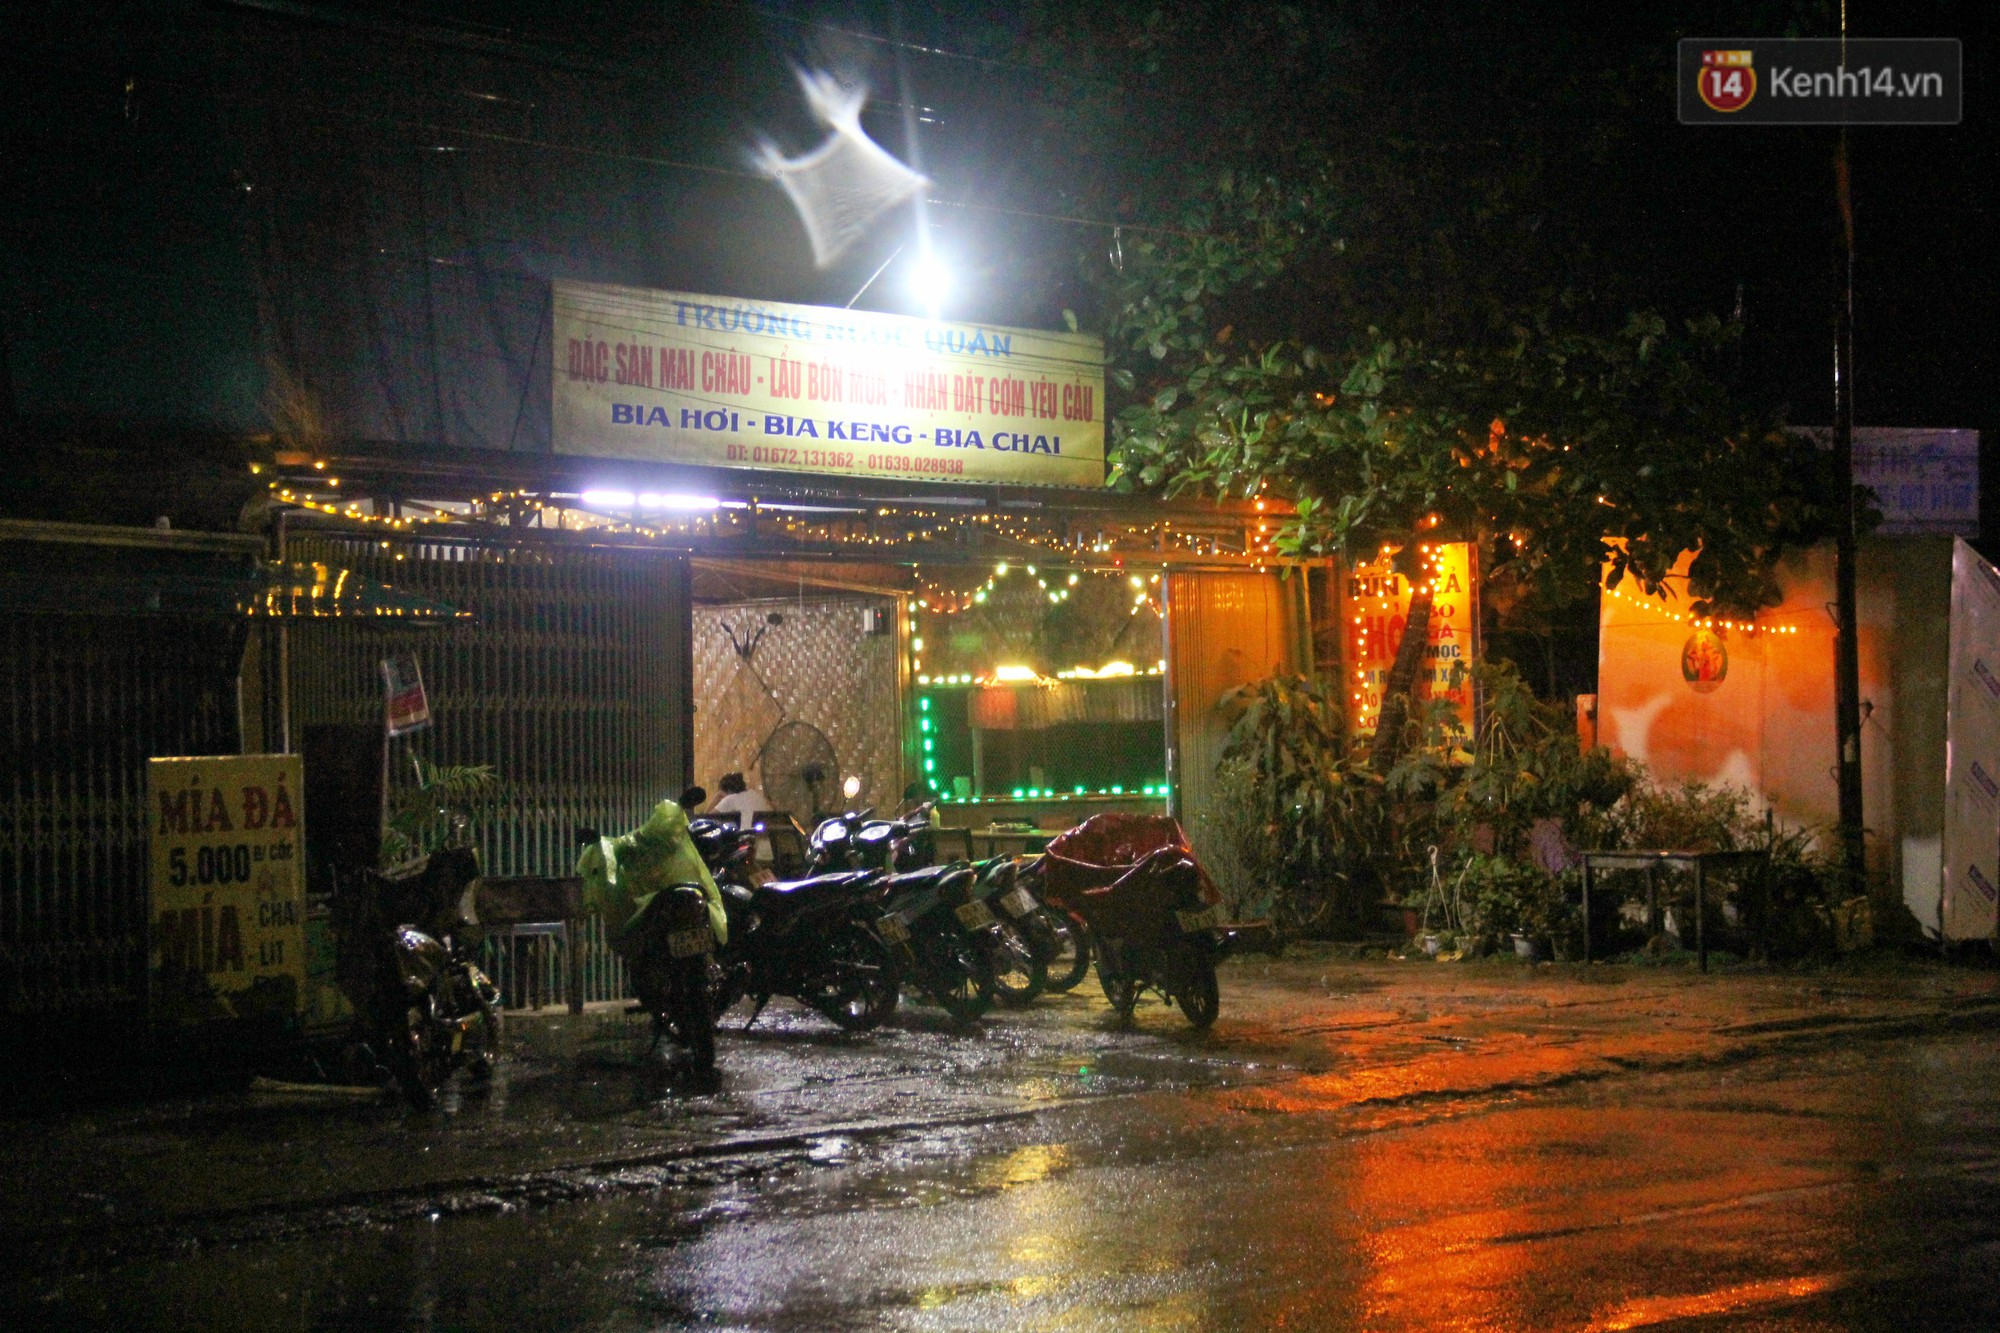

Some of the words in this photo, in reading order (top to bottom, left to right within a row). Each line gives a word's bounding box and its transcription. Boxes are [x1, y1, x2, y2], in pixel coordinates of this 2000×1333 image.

[660, 346, 695, 391] MAI
[702, 346, 751, 396] CHÂU
[989, 373, 1024, 417] CƠM
[1030, 375, 1057, 420] YÊU
[612, 403, 671, 428] BIA
[681, 406, 739, 432] HƠI
[765, 415, 818, 438] BIA
[828, 420, 912, 444] KENG
[935, 428, 985, 449] BIA
[992, 432, 1060, 454] CHAI
[752, 446, 854, 468] 01672.131362
[868, 454, 963, 475] 01639.028938
[159, 774, 233, 835] MÍA
[242, 771, 297, 831] ĐÁ
[168, 844, 251, 887] 5.000
